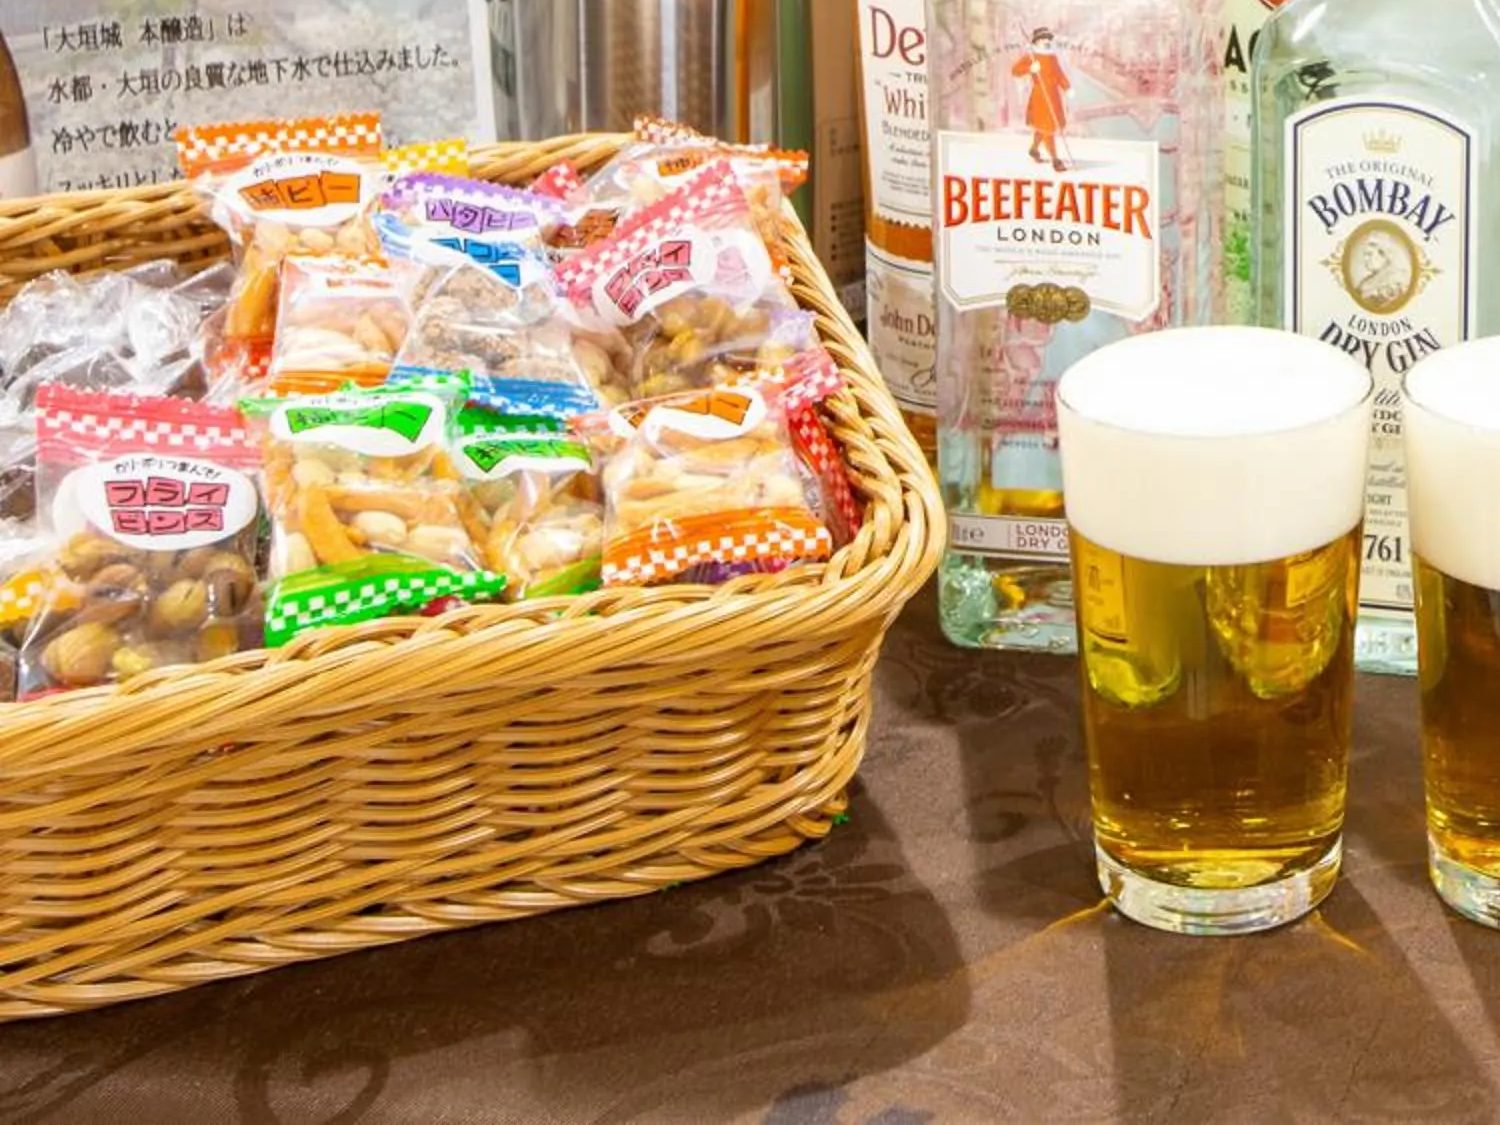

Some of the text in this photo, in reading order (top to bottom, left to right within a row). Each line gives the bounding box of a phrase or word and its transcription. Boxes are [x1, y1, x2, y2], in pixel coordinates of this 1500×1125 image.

[868, 5, 925, 67] De
[1326, 160, 1434, 186] THE ORIGINAL
[943, 174, 1153, 240] BEEFEATER
[1308, 178, 1456, 242] BOMBAY
[997, 226, 1102, 246] LONDON
[1348, 314, 1413, 337] LONDON
[1386, 328, 1441, 375] GIN
[108, 479, 226, 506] フライ
[1016, 524, 1069, 537] LONDO
